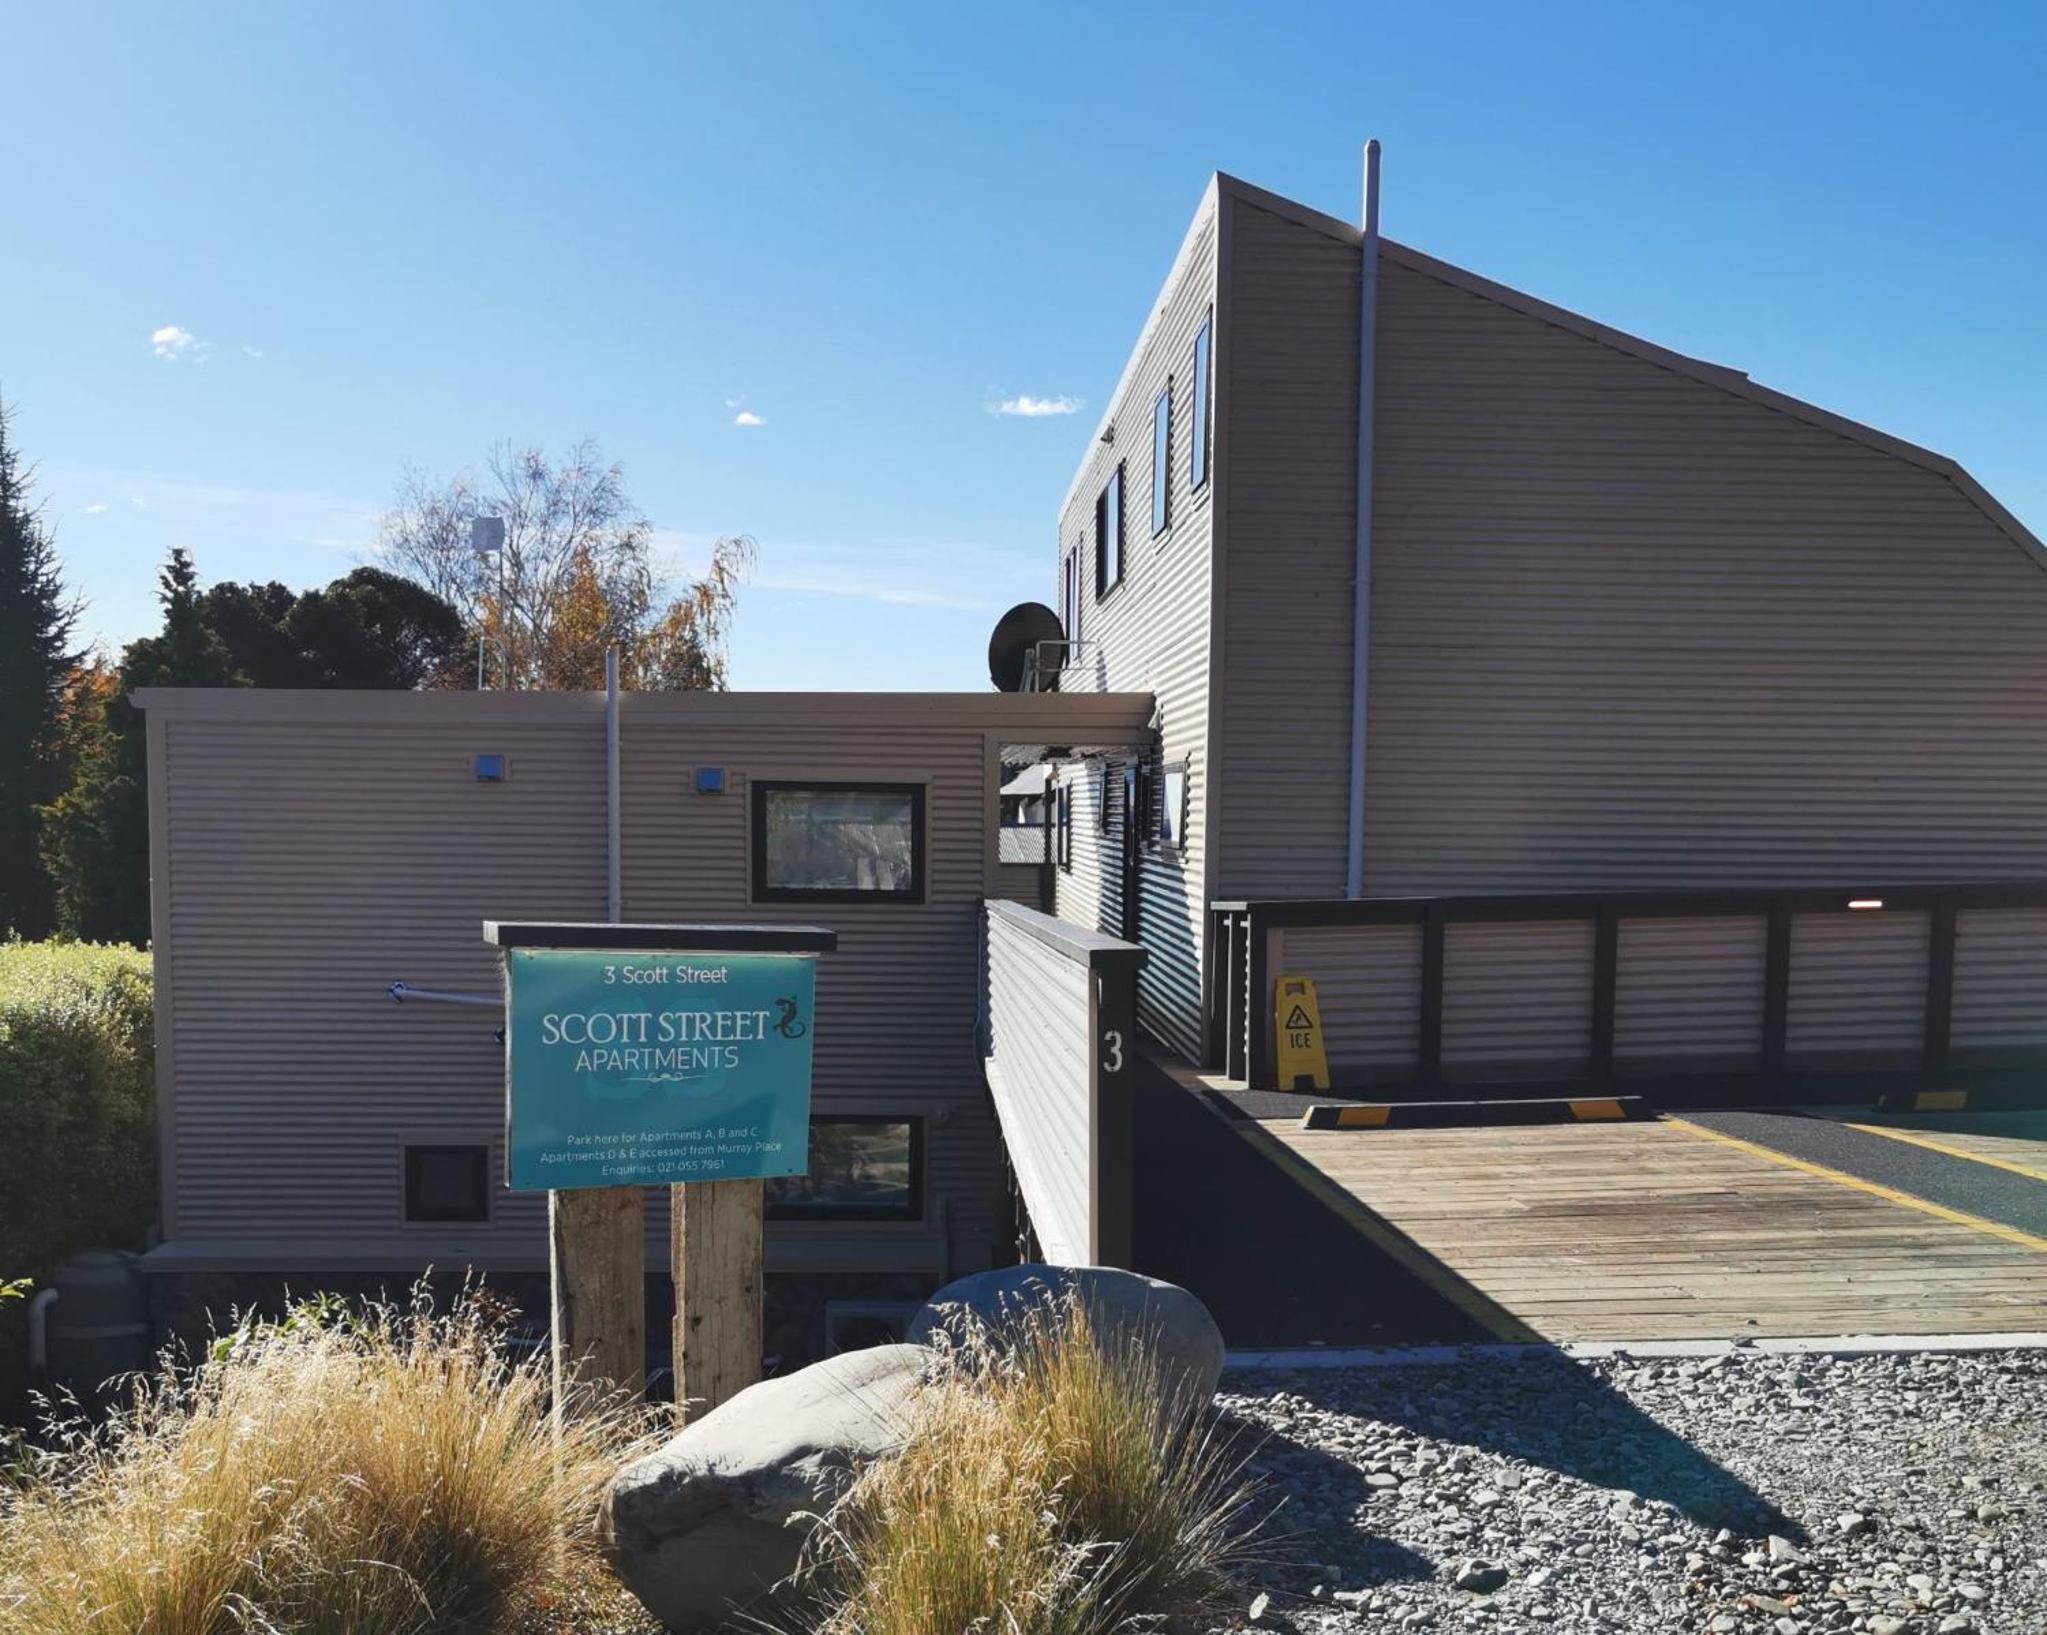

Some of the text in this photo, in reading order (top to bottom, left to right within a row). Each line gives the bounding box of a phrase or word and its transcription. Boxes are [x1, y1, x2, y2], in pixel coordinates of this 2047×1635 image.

[604, 967, 727, 984] 3 Scott Street
[542, 1011, 770, 1044] SCOTT STREET
[1291, 1033, 1312, 1048] ICE
[575, 1047, 738, 1071] APARTMENTS
[1104, 1031, 1122, 1072] 3
[567, 1127, 758, 1145] Park here for Apartments A, B and C
[540, 1141, 783, 1164] Apartments D & E accessed from Murray Place
[602, 1164, 655, 1177] Enquiries:
